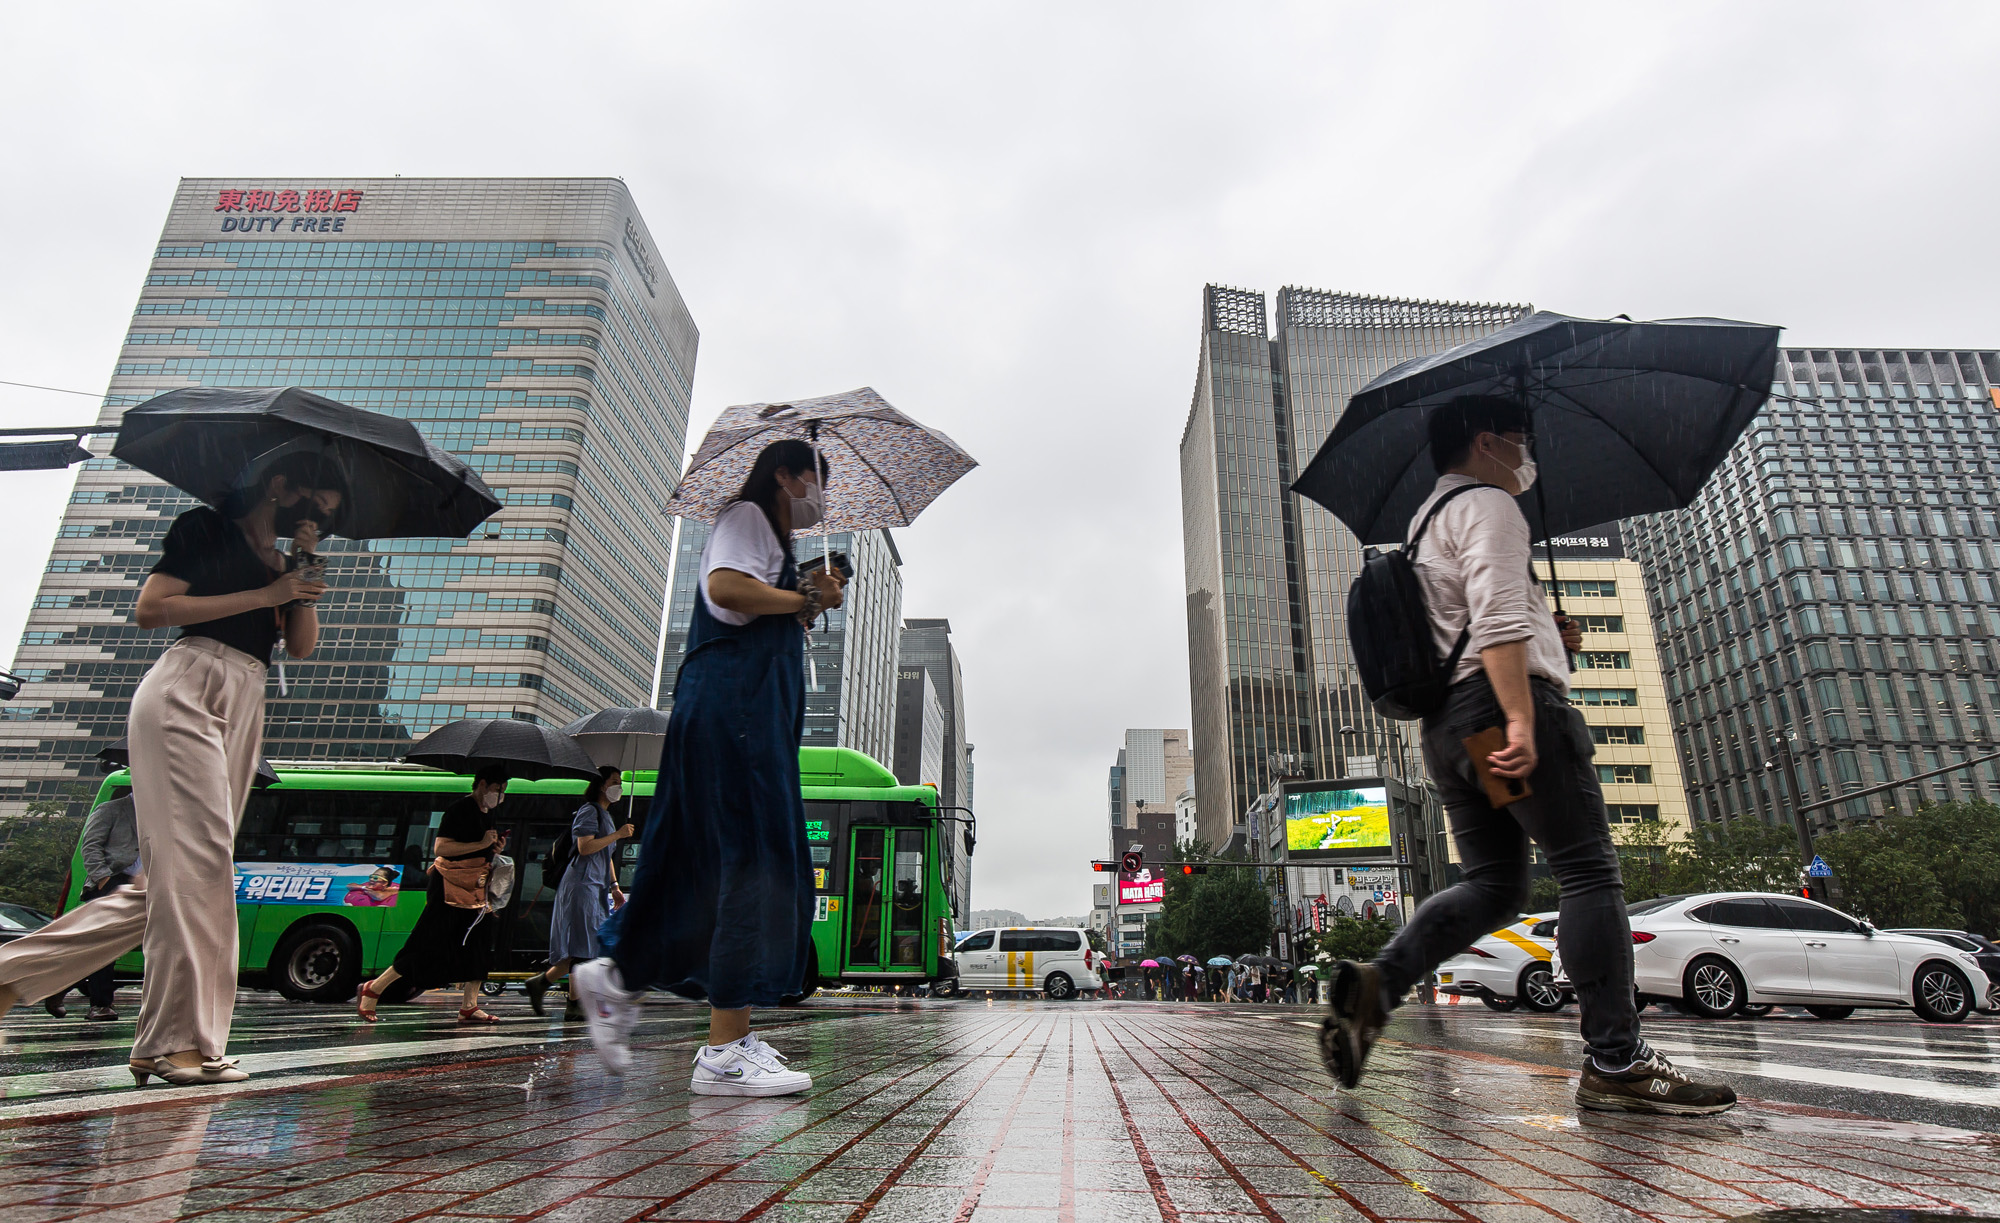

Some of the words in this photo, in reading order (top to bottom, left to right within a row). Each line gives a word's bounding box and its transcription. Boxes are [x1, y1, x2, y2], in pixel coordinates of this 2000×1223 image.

[221, 217, 283, 232] DUTY
[291, 217, 346, 232] FREE
[1550, 537, 1587, 547] 라이프의
[1589, 537, 1609, 547] 중심
[1347, 875, 1394, 885] 강비뇨기과
[245, 876, 332, 900] 워터파크
[1122, 887, 1143, 899] MATA
[1144, 886, 1163, 898] HARI
[1383, 891, 1398, 905] 약
[1650, 1079, 1670, 1096] N
